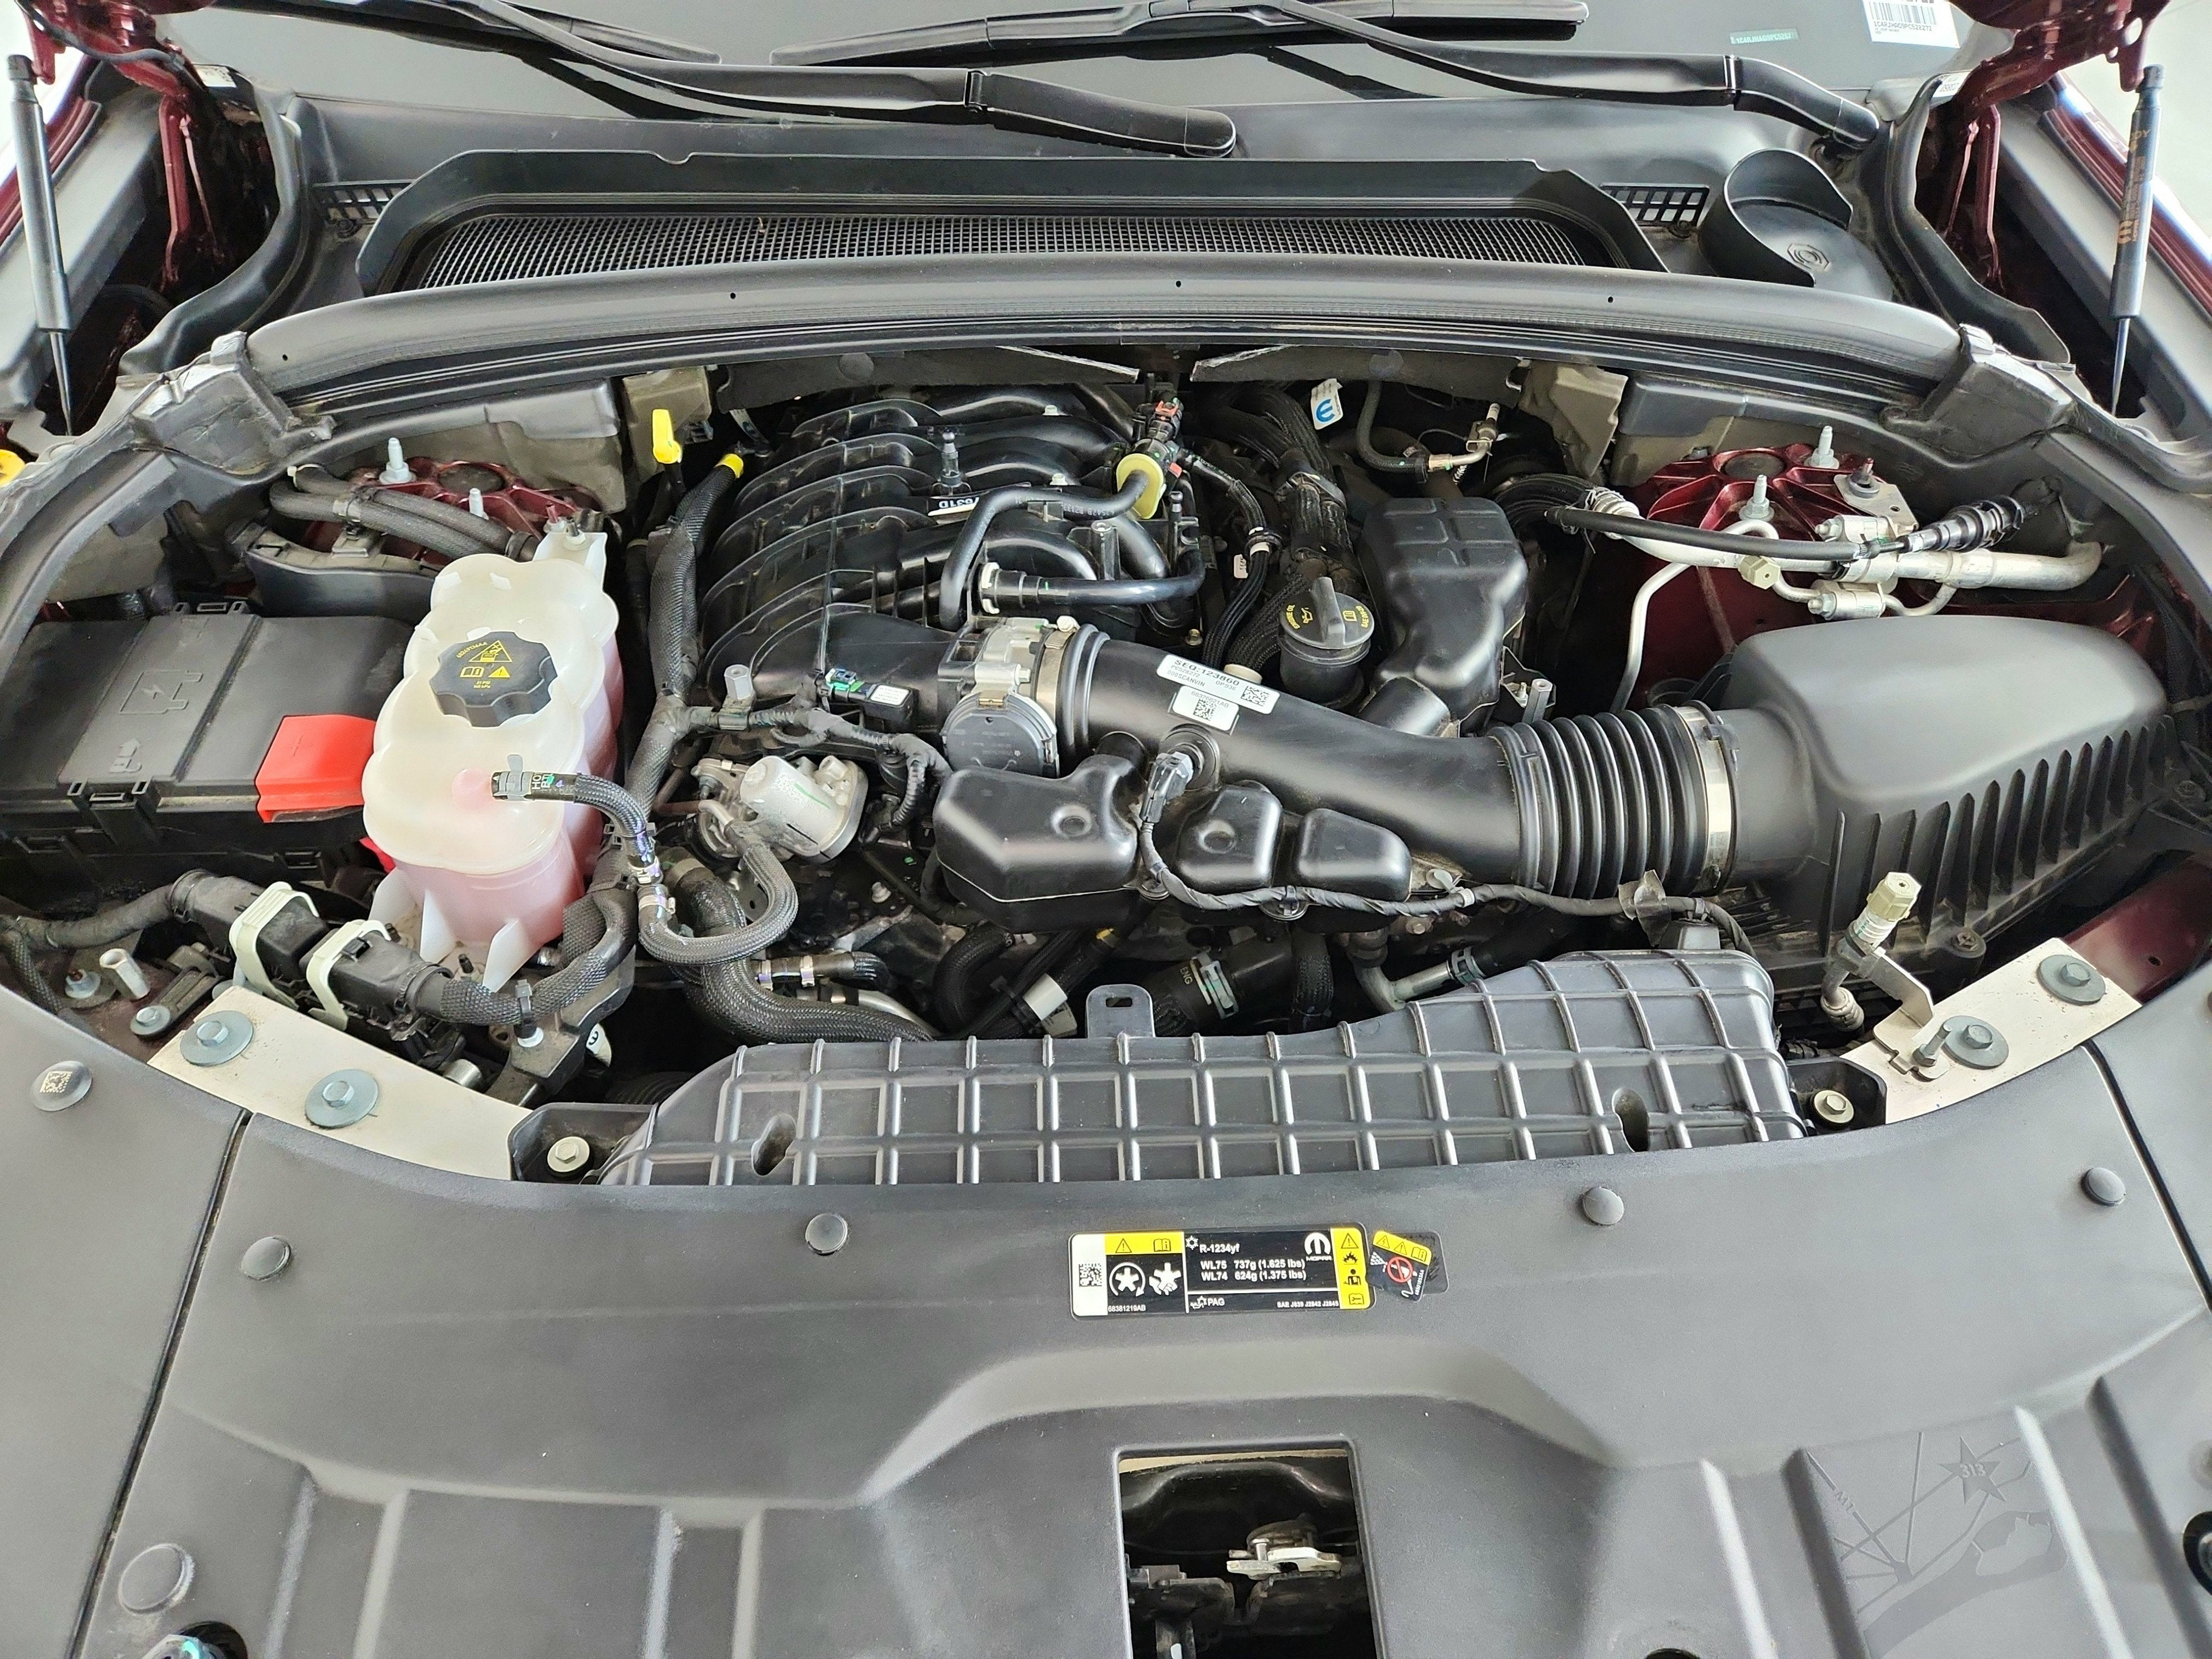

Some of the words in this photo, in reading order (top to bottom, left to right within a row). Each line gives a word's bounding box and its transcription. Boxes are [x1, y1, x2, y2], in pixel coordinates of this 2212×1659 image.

[1171, 665, 1200, 678] PC528272
[1175, 659, 1240, 686] SEQ:123860
[1180, 966, 1193, 985] ENG
[1199, 1243, 1240, 1255] R-1234yf
[1200, 1260, 1228, 1270] WL75
[1233, 1259, 1257, 1271] 737g
[1258, 1259, 1286, 1271] (1.625
[1287, 1258, 1306, 1269] lbs)
[1201, 1271, 1228, 1281] WL74
[1234, 1271, 1257, 1282] 624g
[1259, 1269, 1287, 1282] (1.375
[1288, 1269, 1307, 1281] lbs)
[1207, 1297, 1225, 1306] PAG
[1107, 1304, 1146, 1313] 68381219AB
[1959, 1462, 1987, 1478] 313
